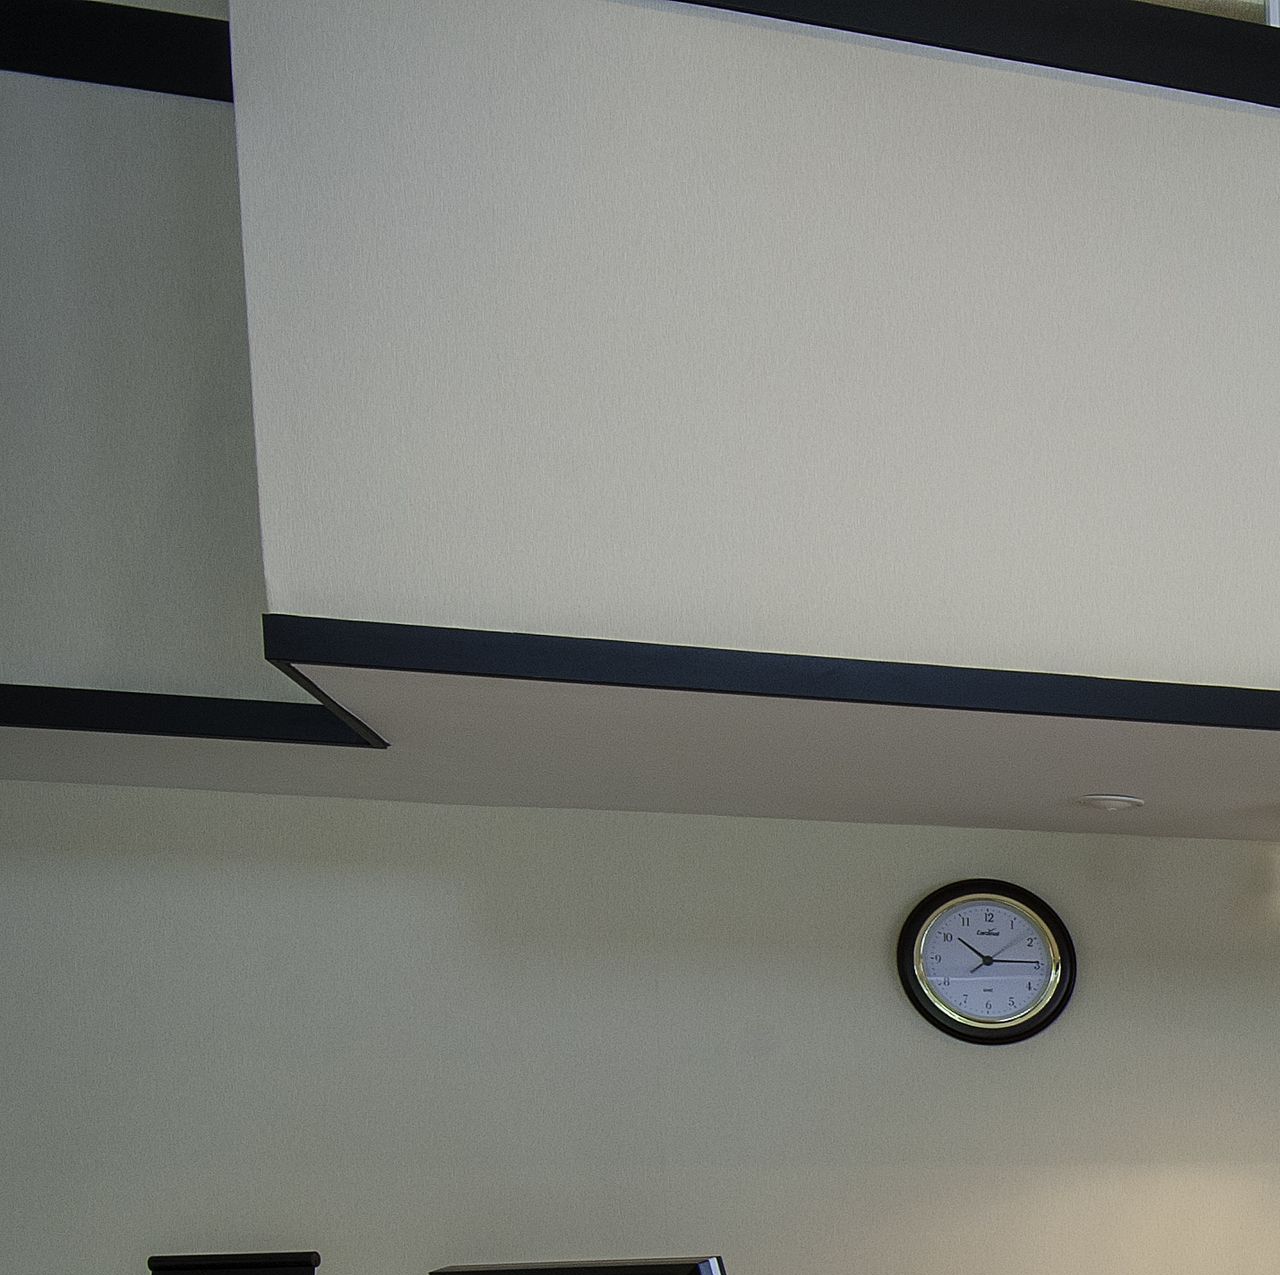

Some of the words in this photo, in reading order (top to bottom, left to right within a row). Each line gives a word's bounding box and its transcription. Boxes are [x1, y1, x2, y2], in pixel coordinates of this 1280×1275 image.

[961, 917, 970, 927] 11
[984, 913, 994, 923] 12
[943, 932, 953, 942] 10
[1026, 938, 1033, 947] 2
[934, 955, 941, 964] 9
[1033, 960, 1041, 970] 3
[943, 977, 950, 987] 8
[1026, 981, 1031, 991] 4
[963, 994, 968, 1004] 7
[1008, 997, 1015, 1006] 5
[985, 1001, 992, 1010] 6
